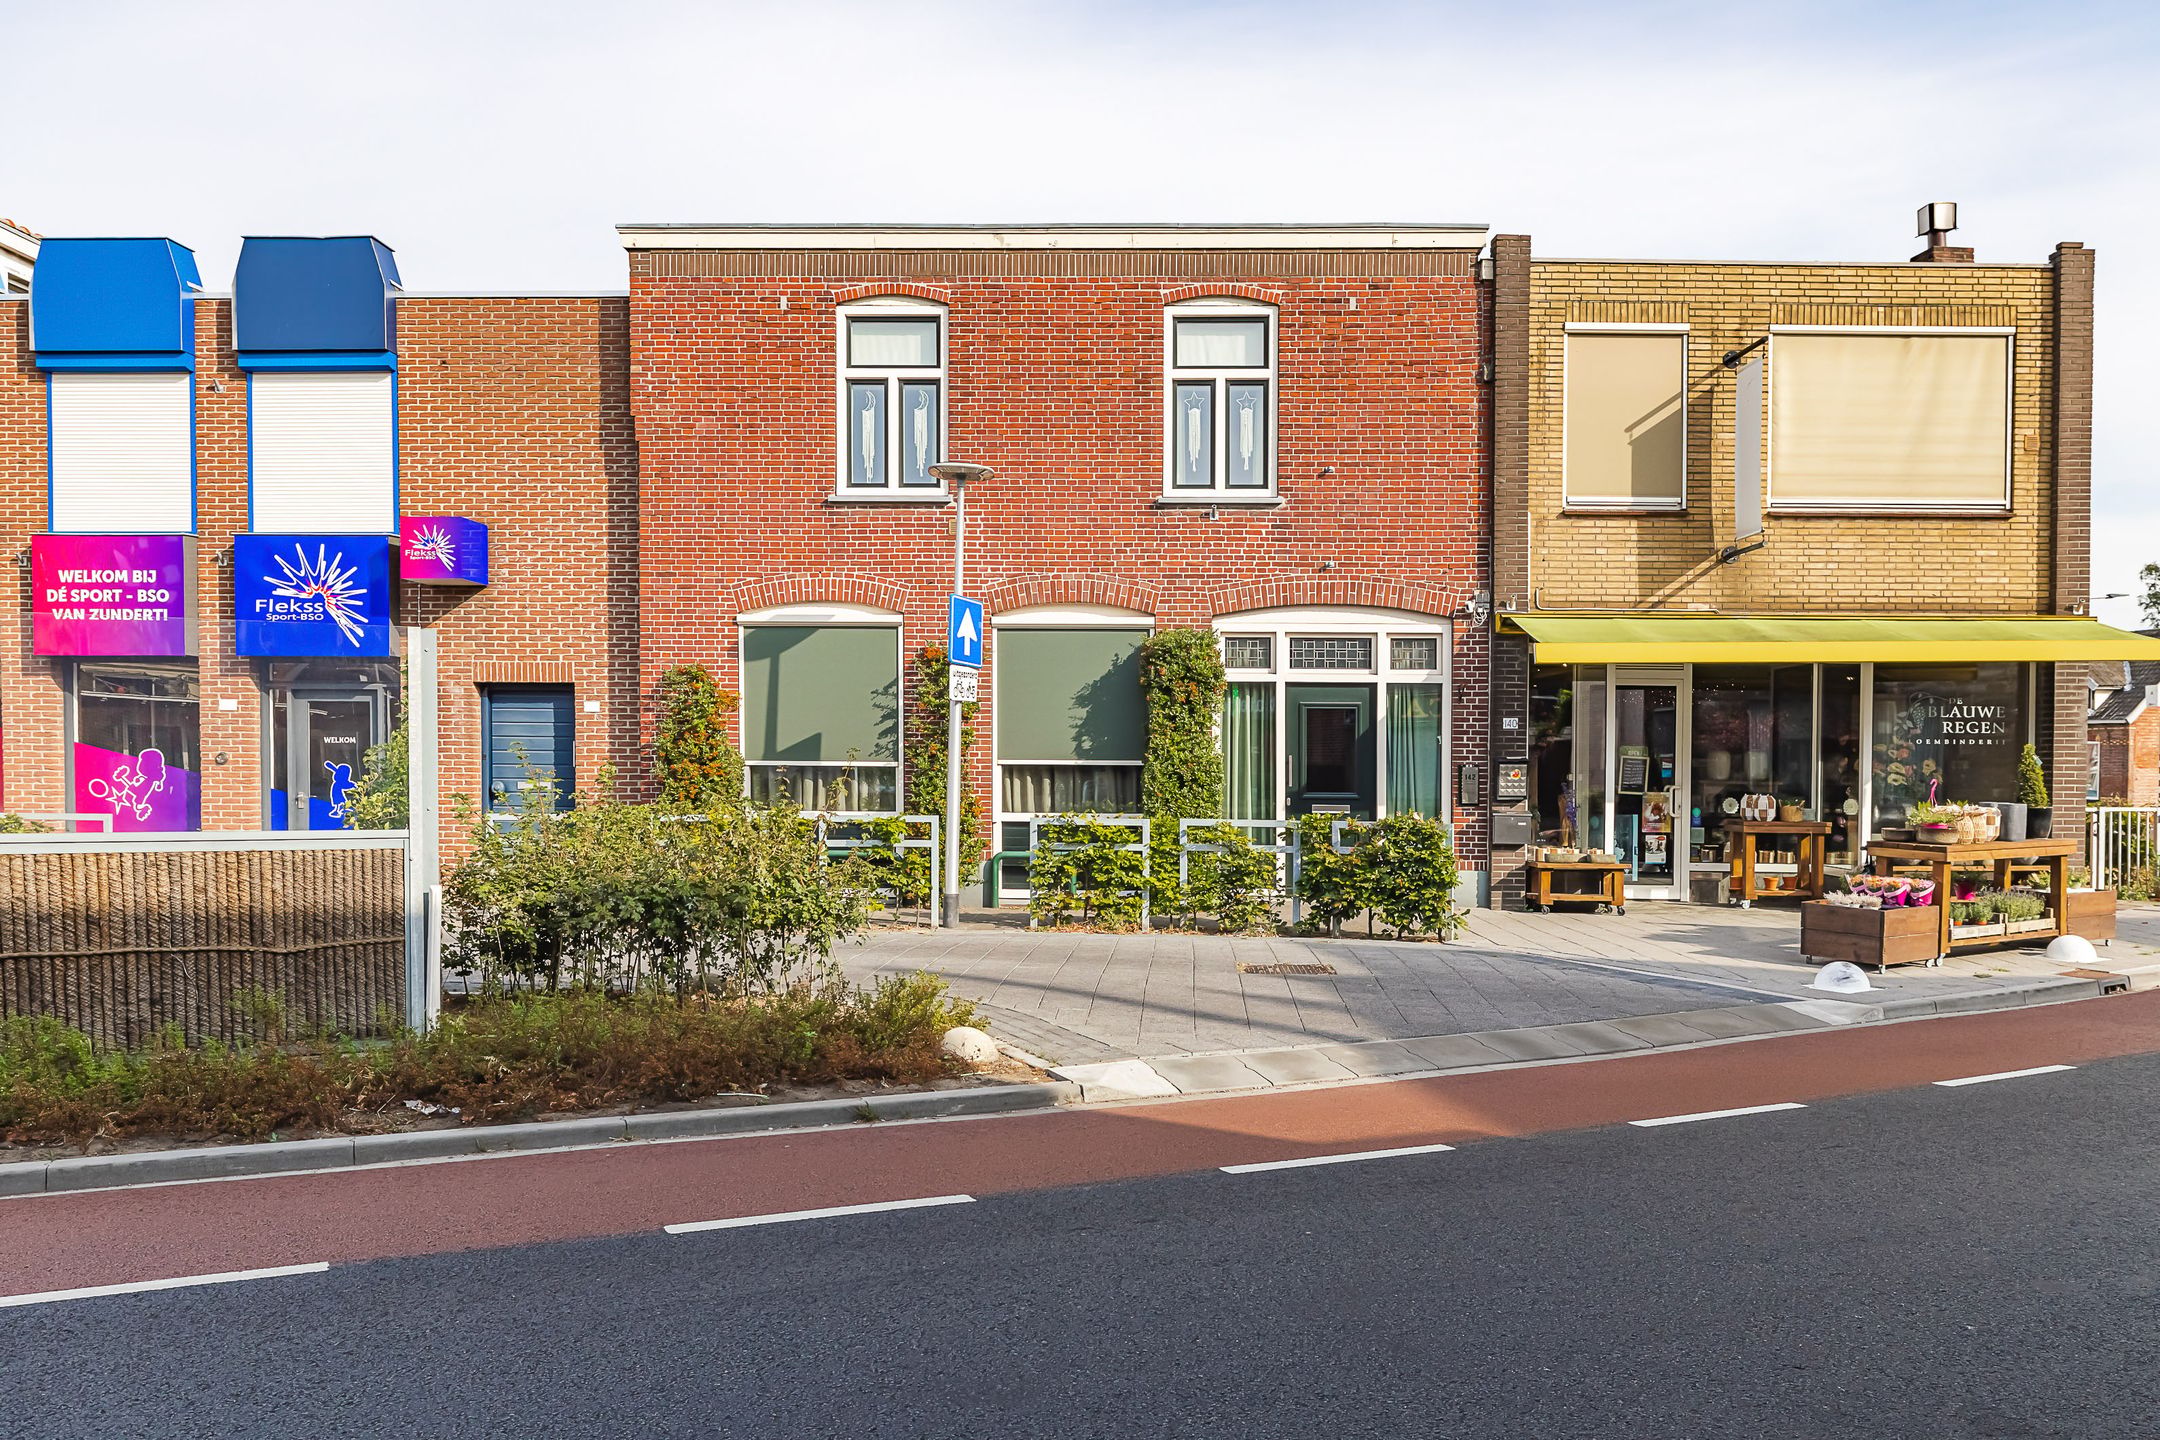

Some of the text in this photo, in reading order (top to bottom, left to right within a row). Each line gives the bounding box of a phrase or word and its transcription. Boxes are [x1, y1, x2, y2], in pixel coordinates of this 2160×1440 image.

[58, 569, 157, 583] WELKOM BIJ
[46, 586, 67, 602] DÉ
[70, 588, 122, 602] SPORT
[137, 588, 170, 602] BSO
[255, 598, 324, 613] Flekss
[52, 608, 168, 621] VAN ZUNDERT!
[266, 613, 324, 621] Sport-BSO
[1949, 697, 1963, 705] DE
[1928, 705, 2006, 718] BLAUWE
[1504, 719, 1518, 728] 140
[1942, 721, 2005, 734] REGEN
[323, 736, 357, 744] WELKOM
